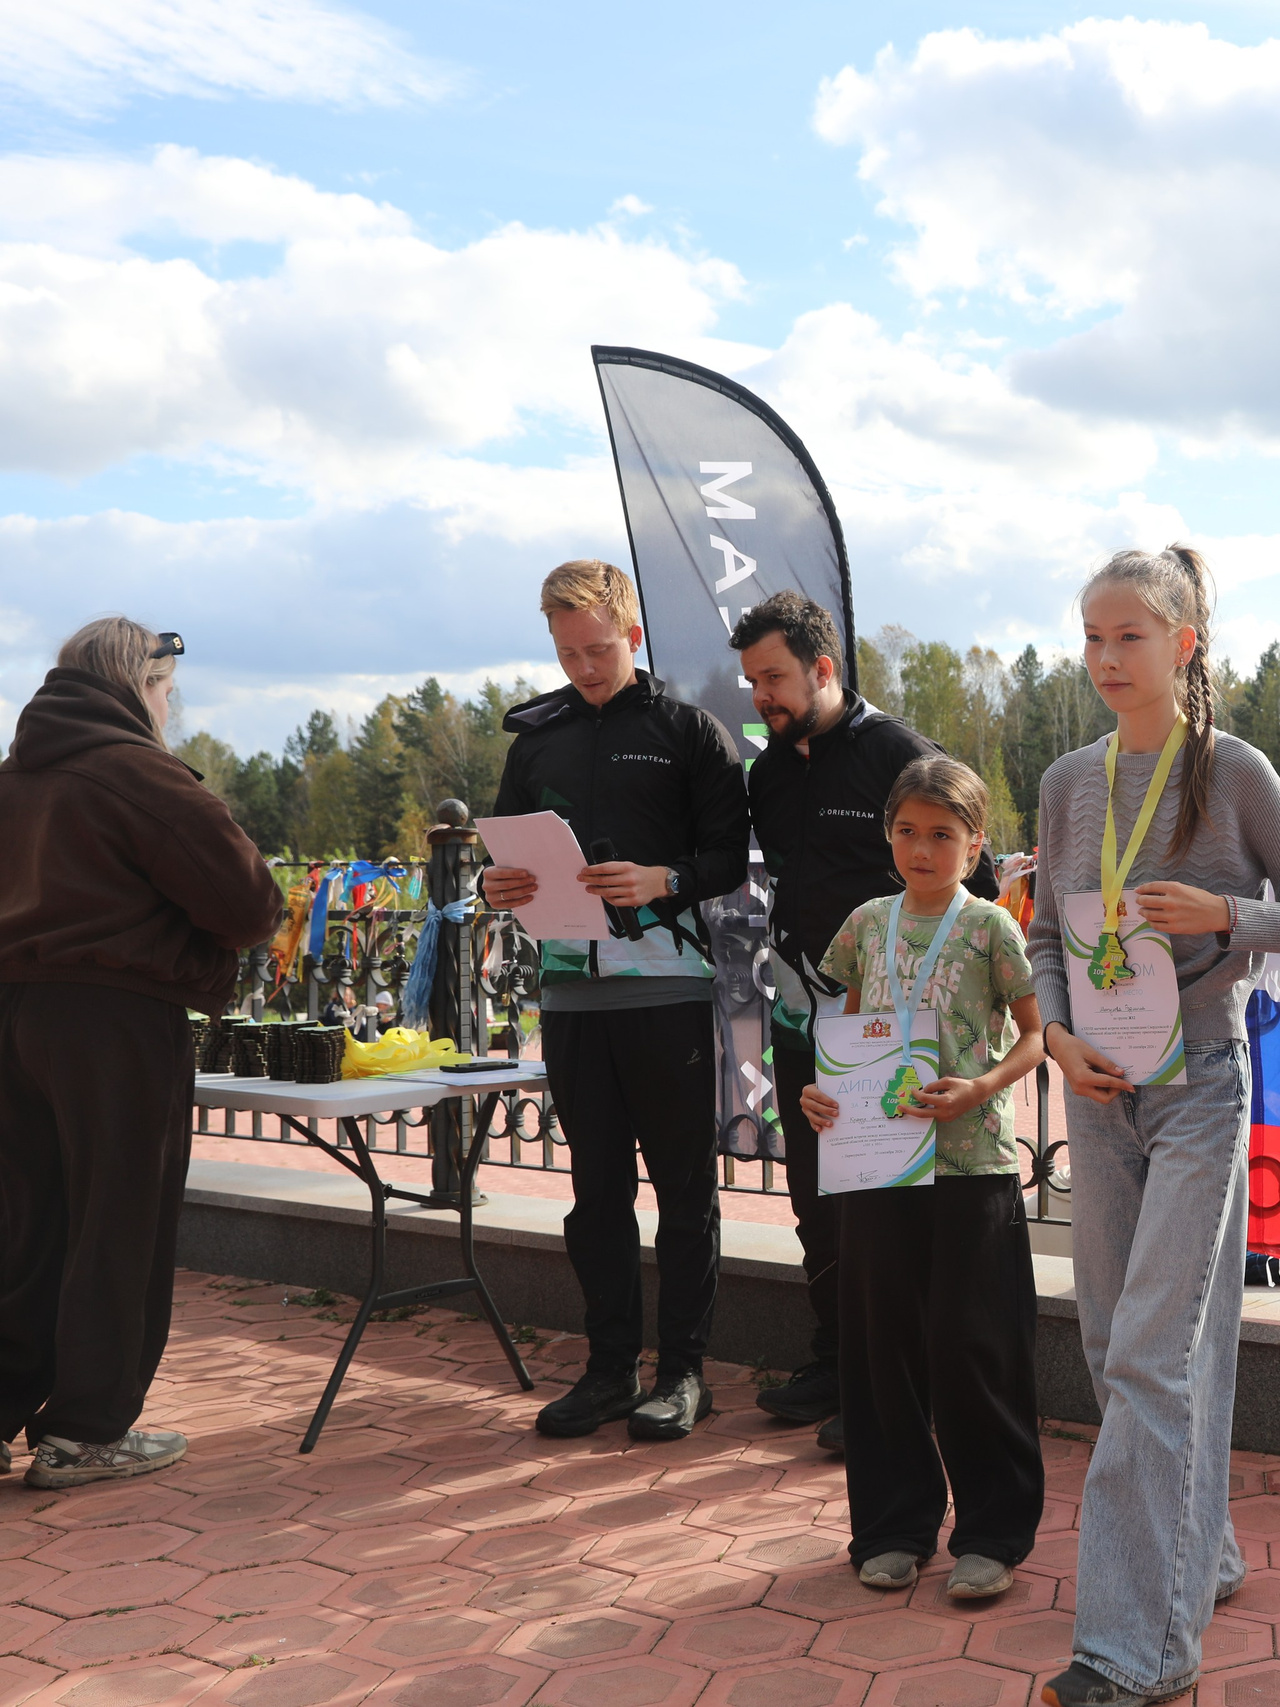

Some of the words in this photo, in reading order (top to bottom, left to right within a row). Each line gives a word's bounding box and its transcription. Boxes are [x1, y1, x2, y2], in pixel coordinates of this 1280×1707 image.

[622, 754, 671, 765] ORIENTEAM
[827, 798, 875, 819] ORIENTEAM
[836, 1078, 894, 1096] ДИПЛ
